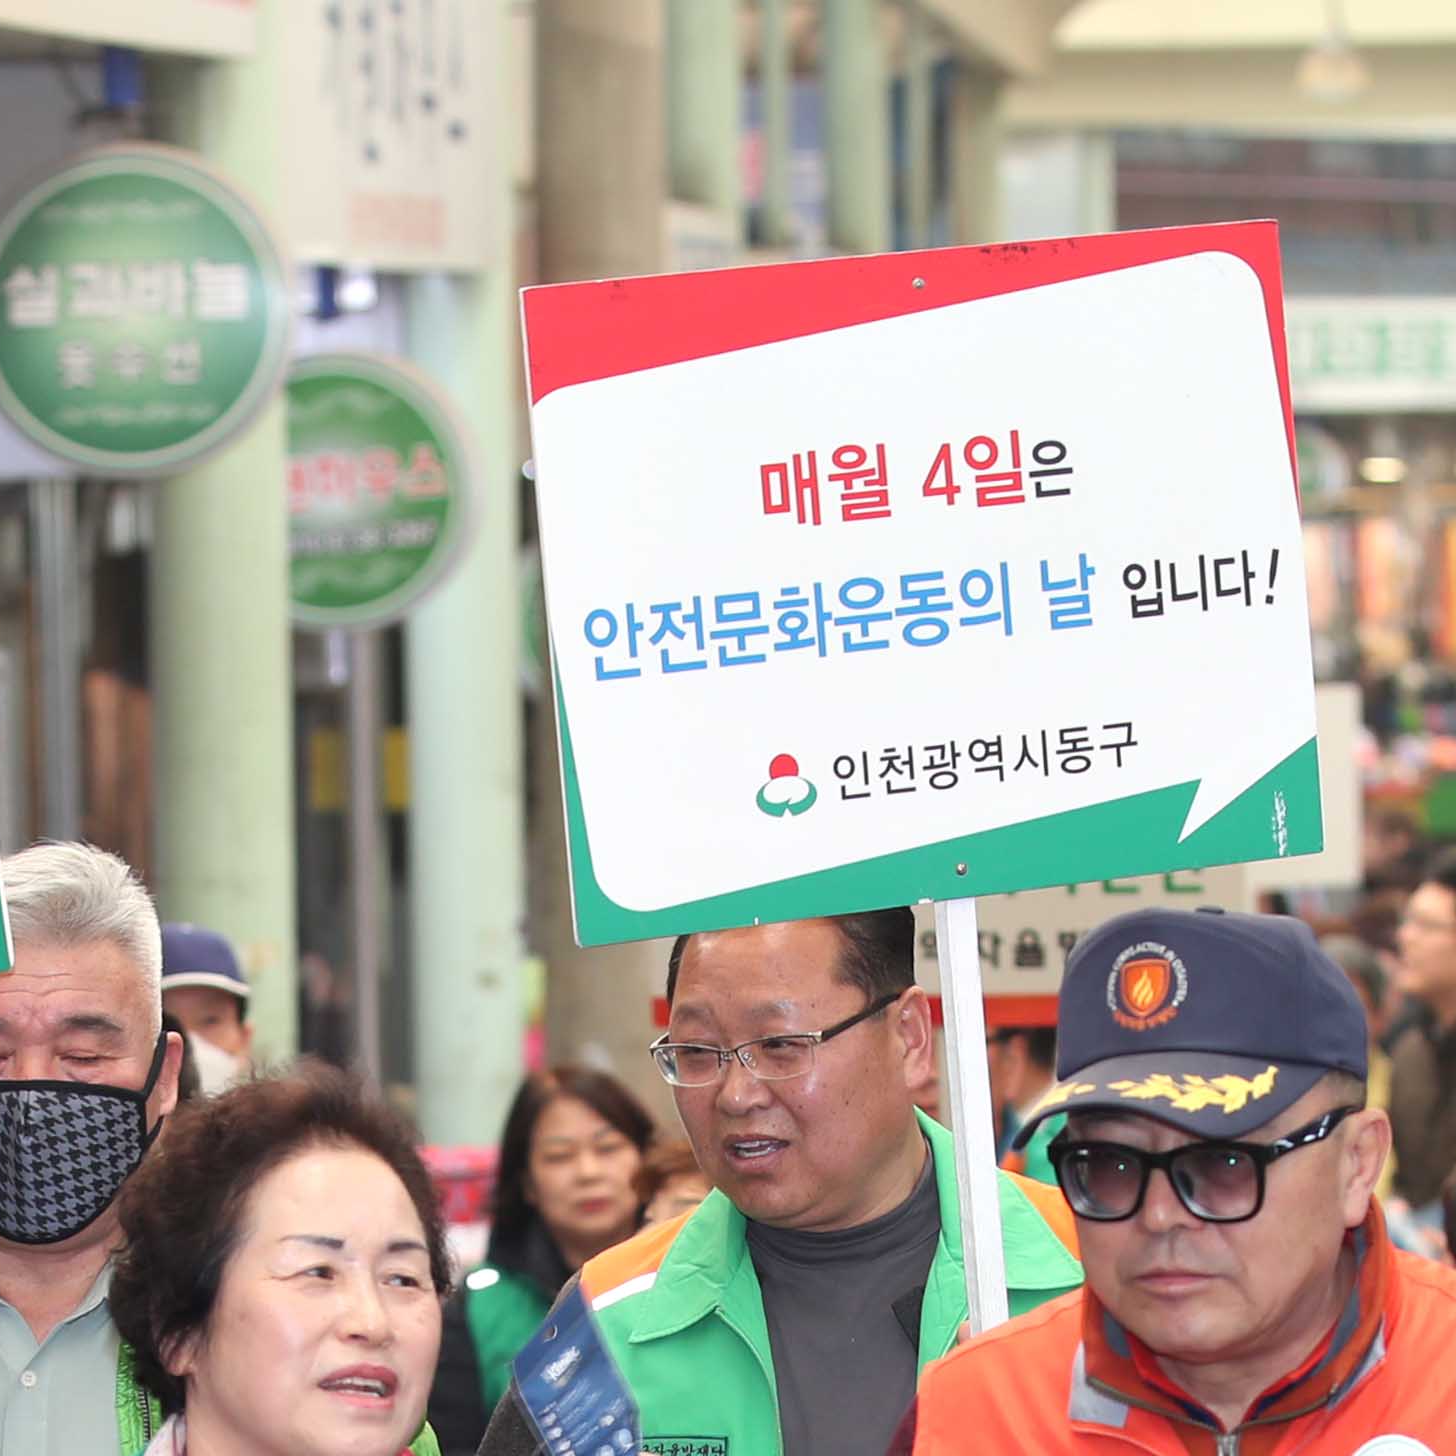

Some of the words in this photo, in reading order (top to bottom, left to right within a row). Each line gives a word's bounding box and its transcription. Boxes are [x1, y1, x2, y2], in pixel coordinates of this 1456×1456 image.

[759, 443, 892, 526] 매월
[923, 430, 1074, 508] 4일은
[582, 560, 1015, 682] 안전문화운동의
[1039, 552, 1097, 630] 날
[1122, 548, 1280, 620] 입니다!
[832, 721, 1139, 802] 인천광역시동구
